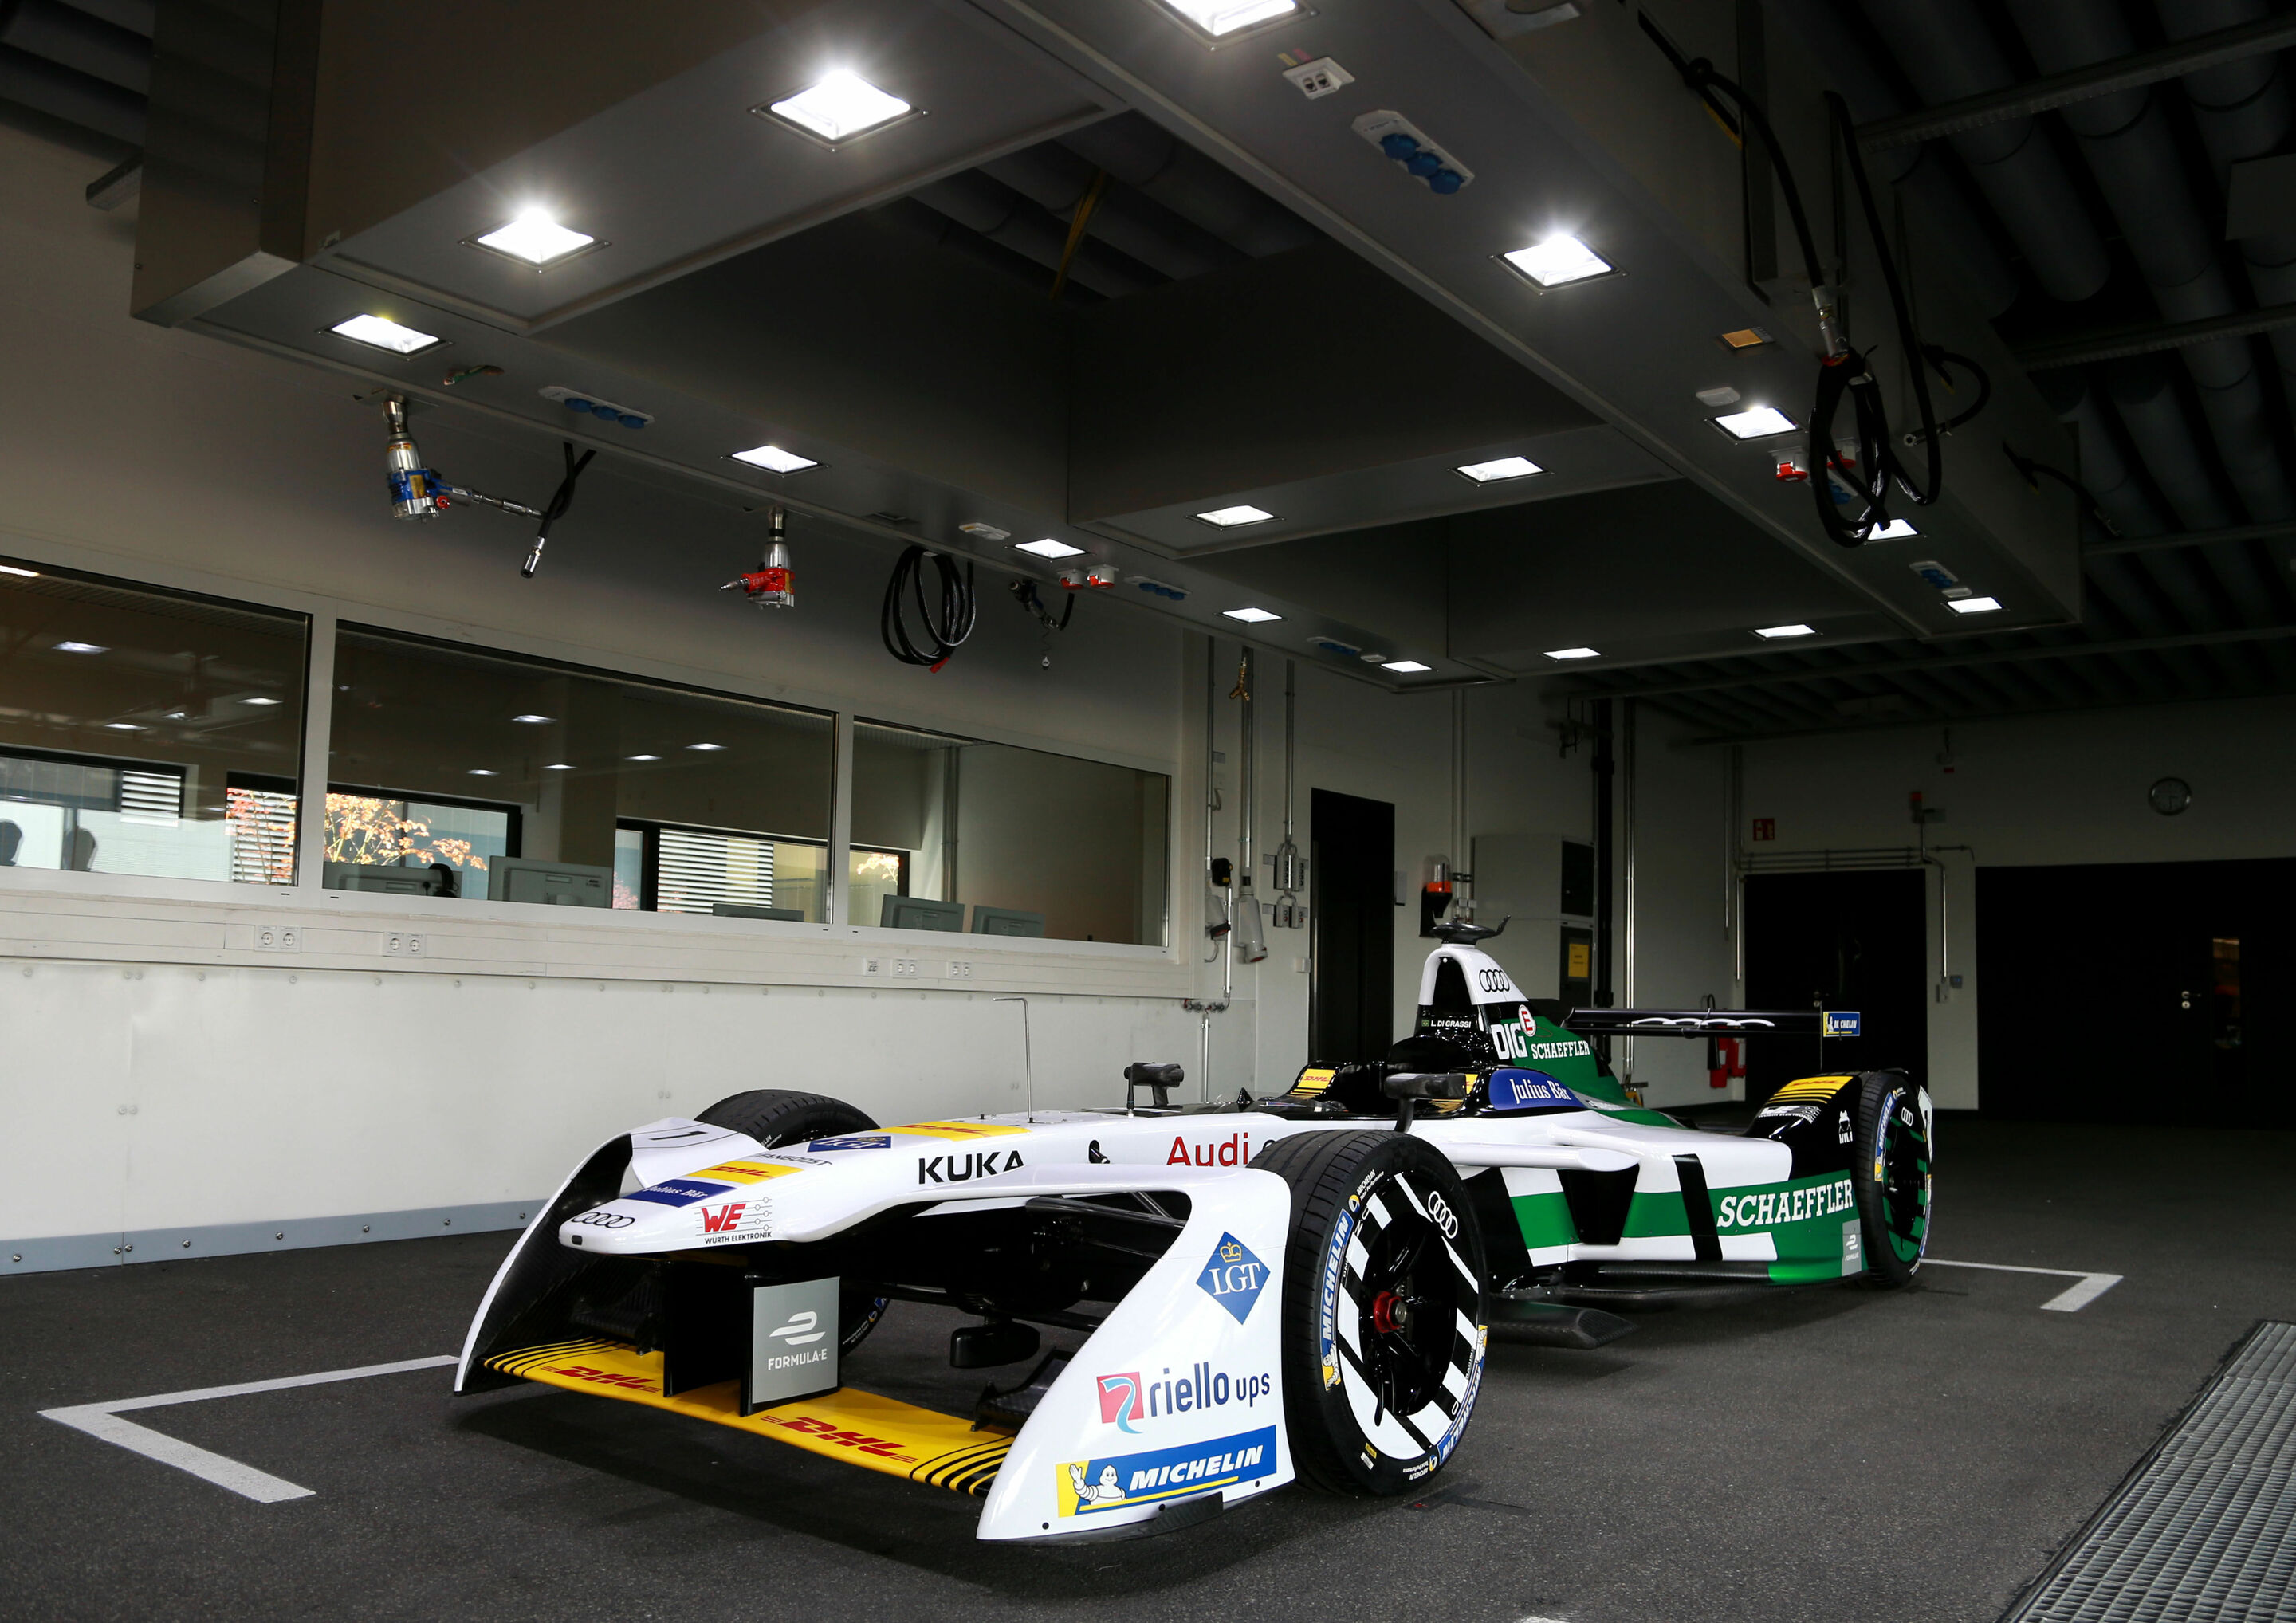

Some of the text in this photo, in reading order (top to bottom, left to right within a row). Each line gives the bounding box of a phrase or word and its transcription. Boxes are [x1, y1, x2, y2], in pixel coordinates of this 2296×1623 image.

[1521, 1011, 1533, 1032] E
[1834, 1020, 1858, 1029] MCHELIN
[1491, 1023, 1528, 1060] DIG
[1531, 1040, 1590, 1059] SCHAEFFLER
[1509, 1078, 1572, 1105] Julius Bär
[1878, 1096, 1893, 1149] MICHELIN
[1166, 1133, 1248, 1166] Audi
[711, 1166, 770, 1177] DHL
[918, 1150, 1024, 1185] KUKA
[1356, 1169, 1376, 1196] MICHELIN
[702, 1204, 746, 1233] WE
[1716, 1178, 1854, 1228] SCHAEFFLER
[704, 1232, 772, 1244] WÜRTH ELEKTRONIK
[1209, 1262, 1260, 1295] LGT
[1322, 1215, 1350, 1341] MICHELIN
[557, 1366, 658, 1390] DHL
[1150, 1362, 1271, 1417] riello ups
[1442, 1366, 1482, 1459] MICHELIN
[777, 1417, 906, 1457] DHL
[1129, 1444, 1264, 1491] MICHELIN
